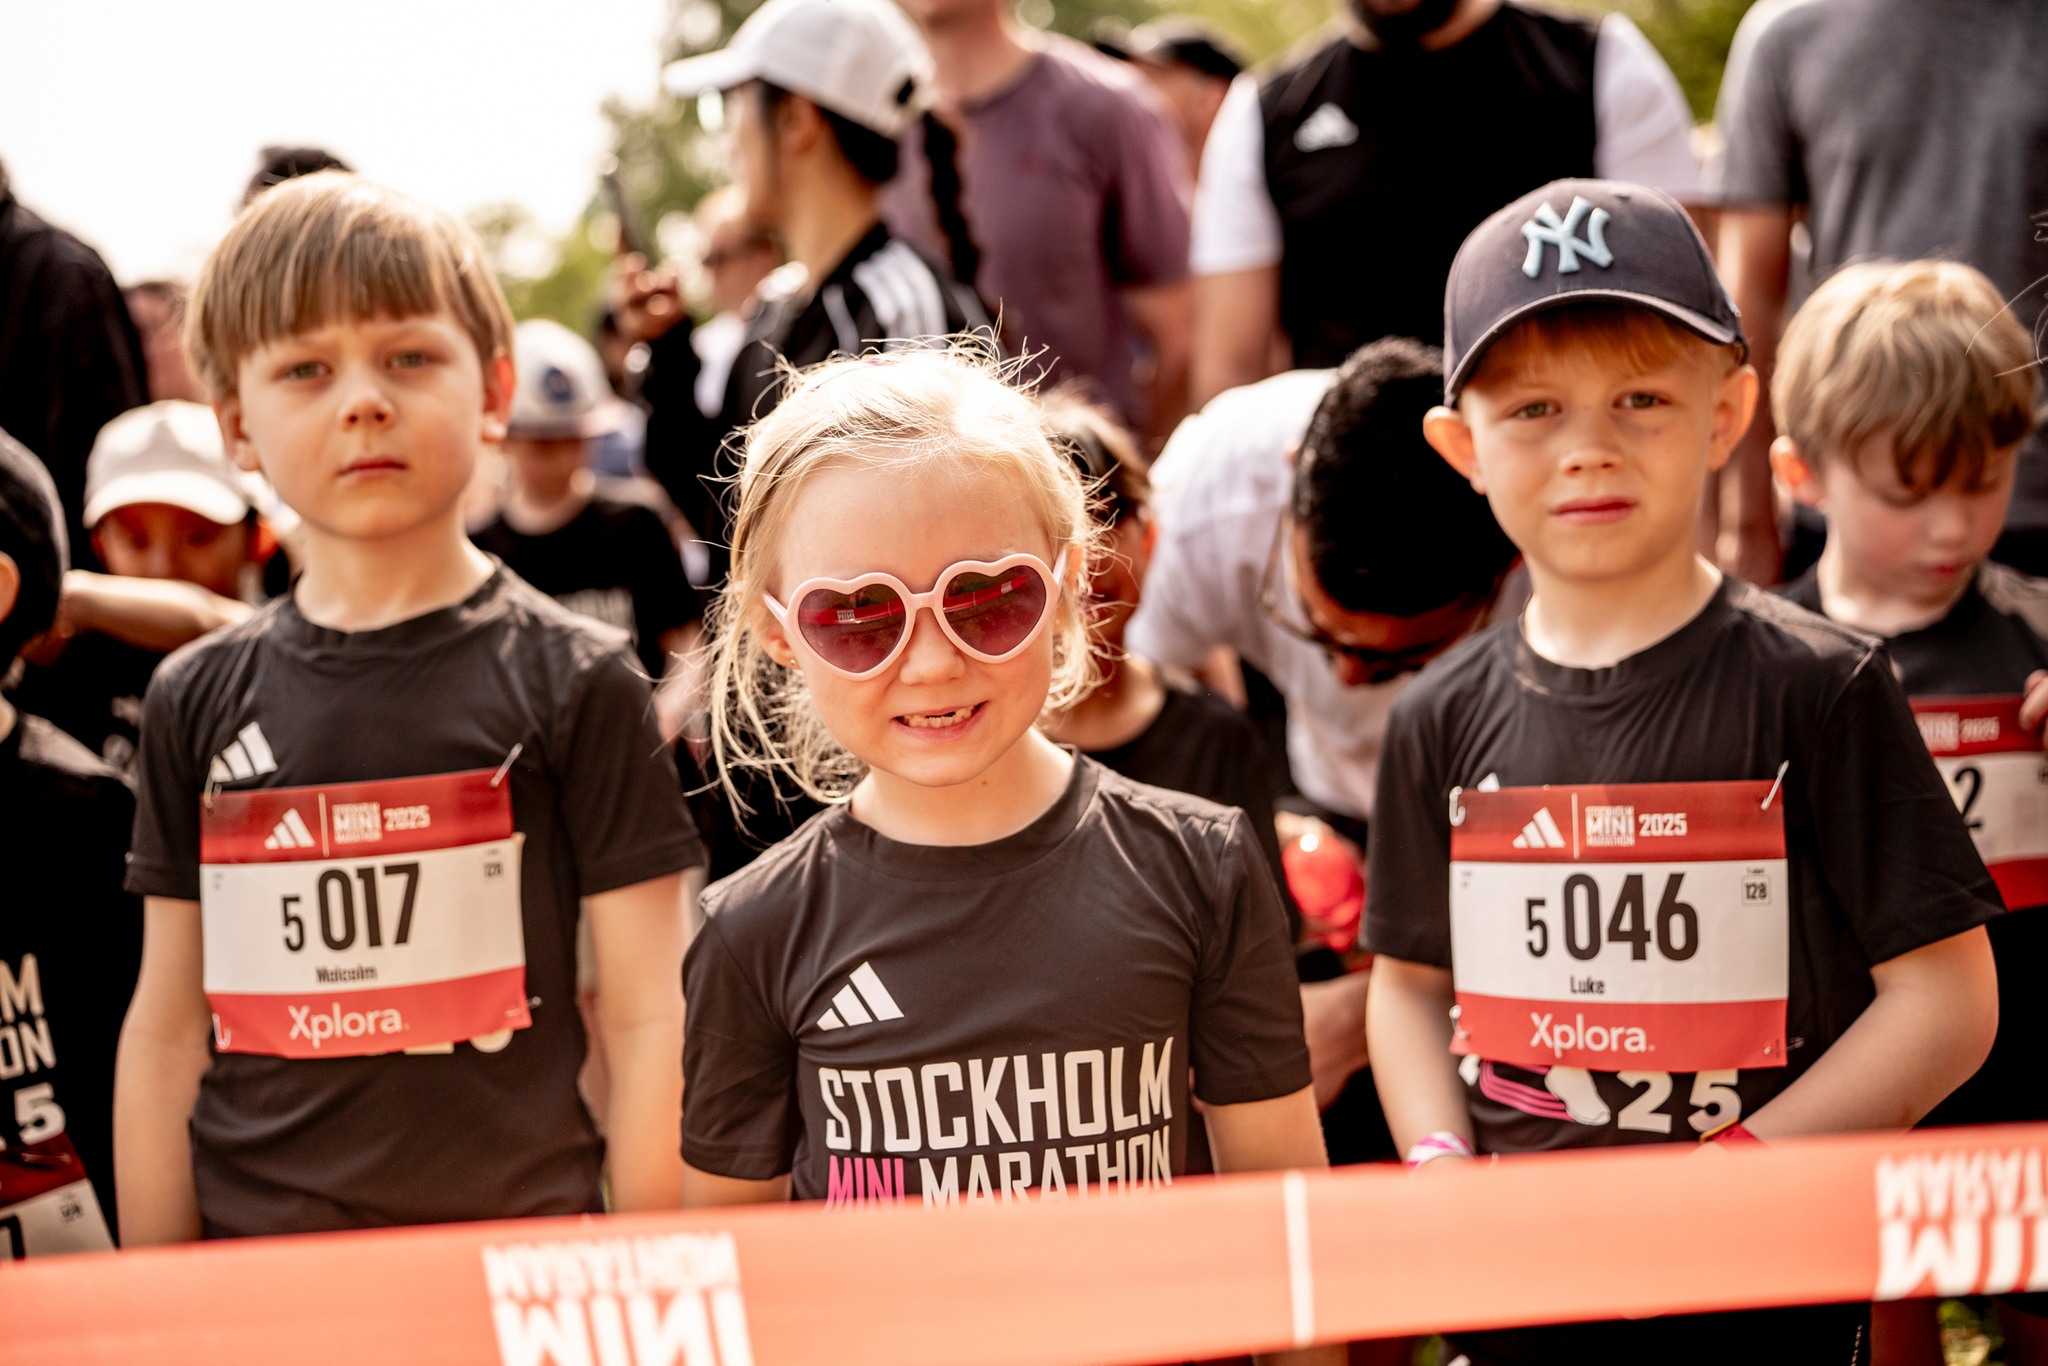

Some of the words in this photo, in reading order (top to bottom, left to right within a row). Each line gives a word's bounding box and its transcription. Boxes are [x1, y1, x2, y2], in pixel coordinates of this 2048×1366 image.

[1520, 196, 1614, 279] NY
[333, 811, 381, 832] MINI
[383, 805, 431, 831] 2025
[1585, 815, 1635, 835] MINI
[1638, 813, 1687, 837] 2025
[1745, 882, 1767, 900] 128
[1570, 976, 1605, 995] Luke
[818, 1036, 1175, 1153] STOCKHOLM
[825, 1154, 905, 1210] MINI
[919, 1125, 1173, 1208] MARATHON
